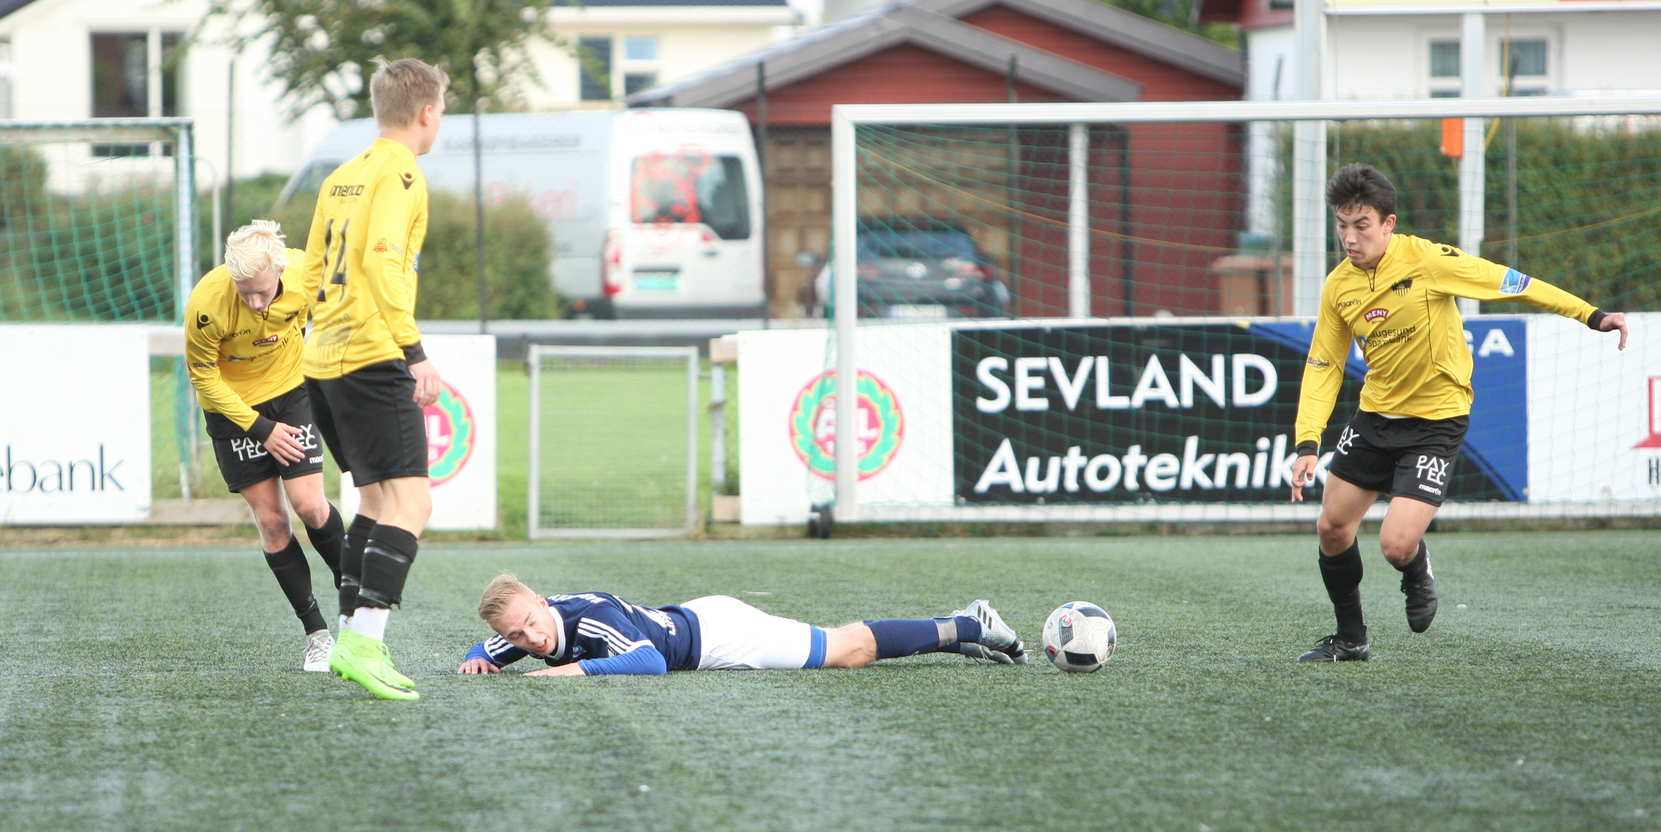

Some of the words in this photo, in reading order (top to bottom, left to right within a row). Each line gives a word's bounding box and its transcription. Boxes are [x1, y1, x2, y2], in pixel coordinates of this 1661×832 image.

[1365, 310, 1388, 320] MENY
[1367, 325, 1416, 339] augesund
[975, 353, 1278, 413] SEVLAND
[1341, 425, 1360, 442] AY
[1336, 441, 1353, 455] EC
[0, 442, 125, 494] bank
[1415, 454, 1449, 473] PAY
[1416, 466, 1447, 485] TEC
